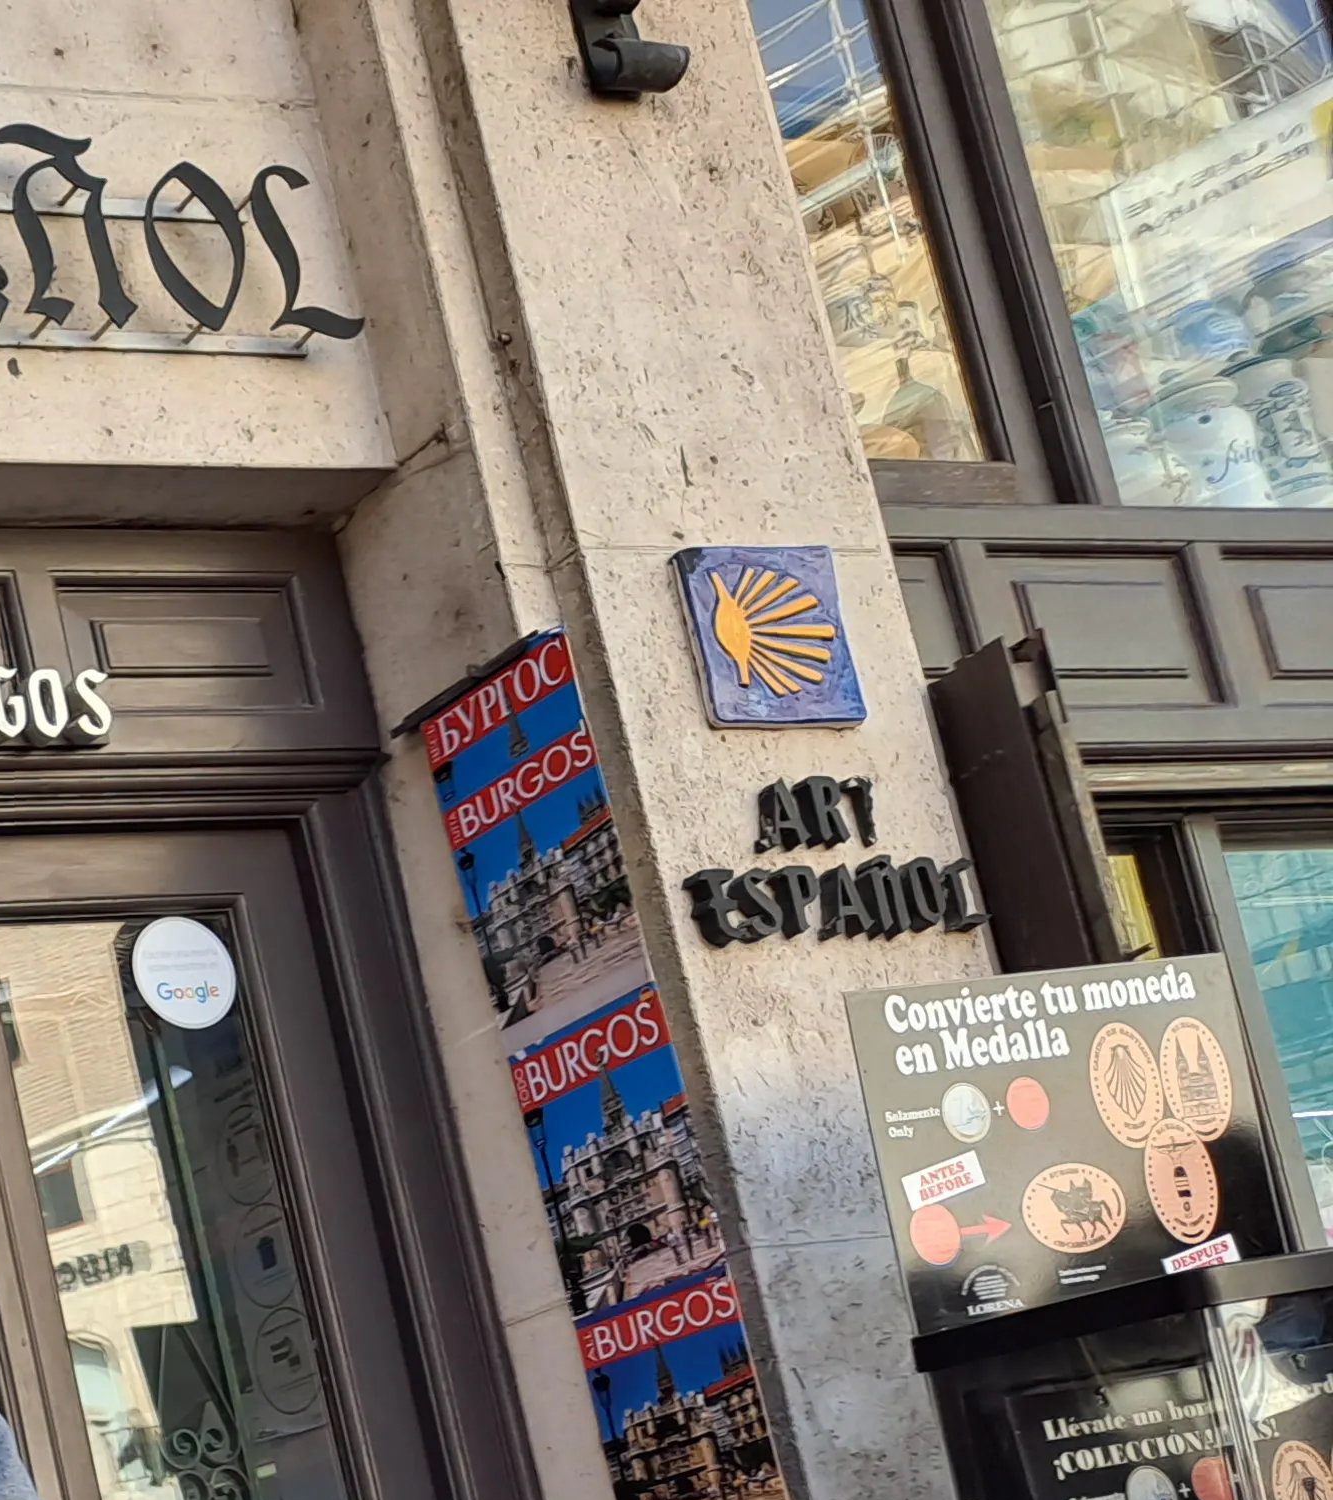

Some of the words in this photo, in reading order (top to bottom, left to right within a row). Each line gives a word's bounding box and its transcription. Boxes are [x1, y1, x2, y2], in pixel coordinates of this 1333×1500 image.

[435, 638, 568, 757] БУРГОС
[457, 730, 592, 838] BURGOS
[754, 775, 876, 853] ART
[682, 854, 991, 948] ESPAÑOL
[156, 981, 220, 1003] Google
[884, 985, 1037, 1034] Convierte
[1040, 980, 1078, 1015] tu
[1082, 964, 1196, 1011] moneda
[525, 1002, 660, 1102] BURGOS
[895, 1042, 938, 1075] en
[939, 1018, 1071, 1070] Medalla
[514, 1068, 531, 1108] TODO
[888, 1126, 915, 1140] Only
[918, 1172, 974, 1202] BEFORE
[919, 1160, 965, 1187] ANTES
[1170, 1239, 1231, 1272] DESPUES
[595, 1282, 737, 1360] BURGOS
[966, 1297, 1025, 1317] LORENA
[1042, 1413, 1128, 1441] Llévate
[1133, 1411, 1163, 1427] un
